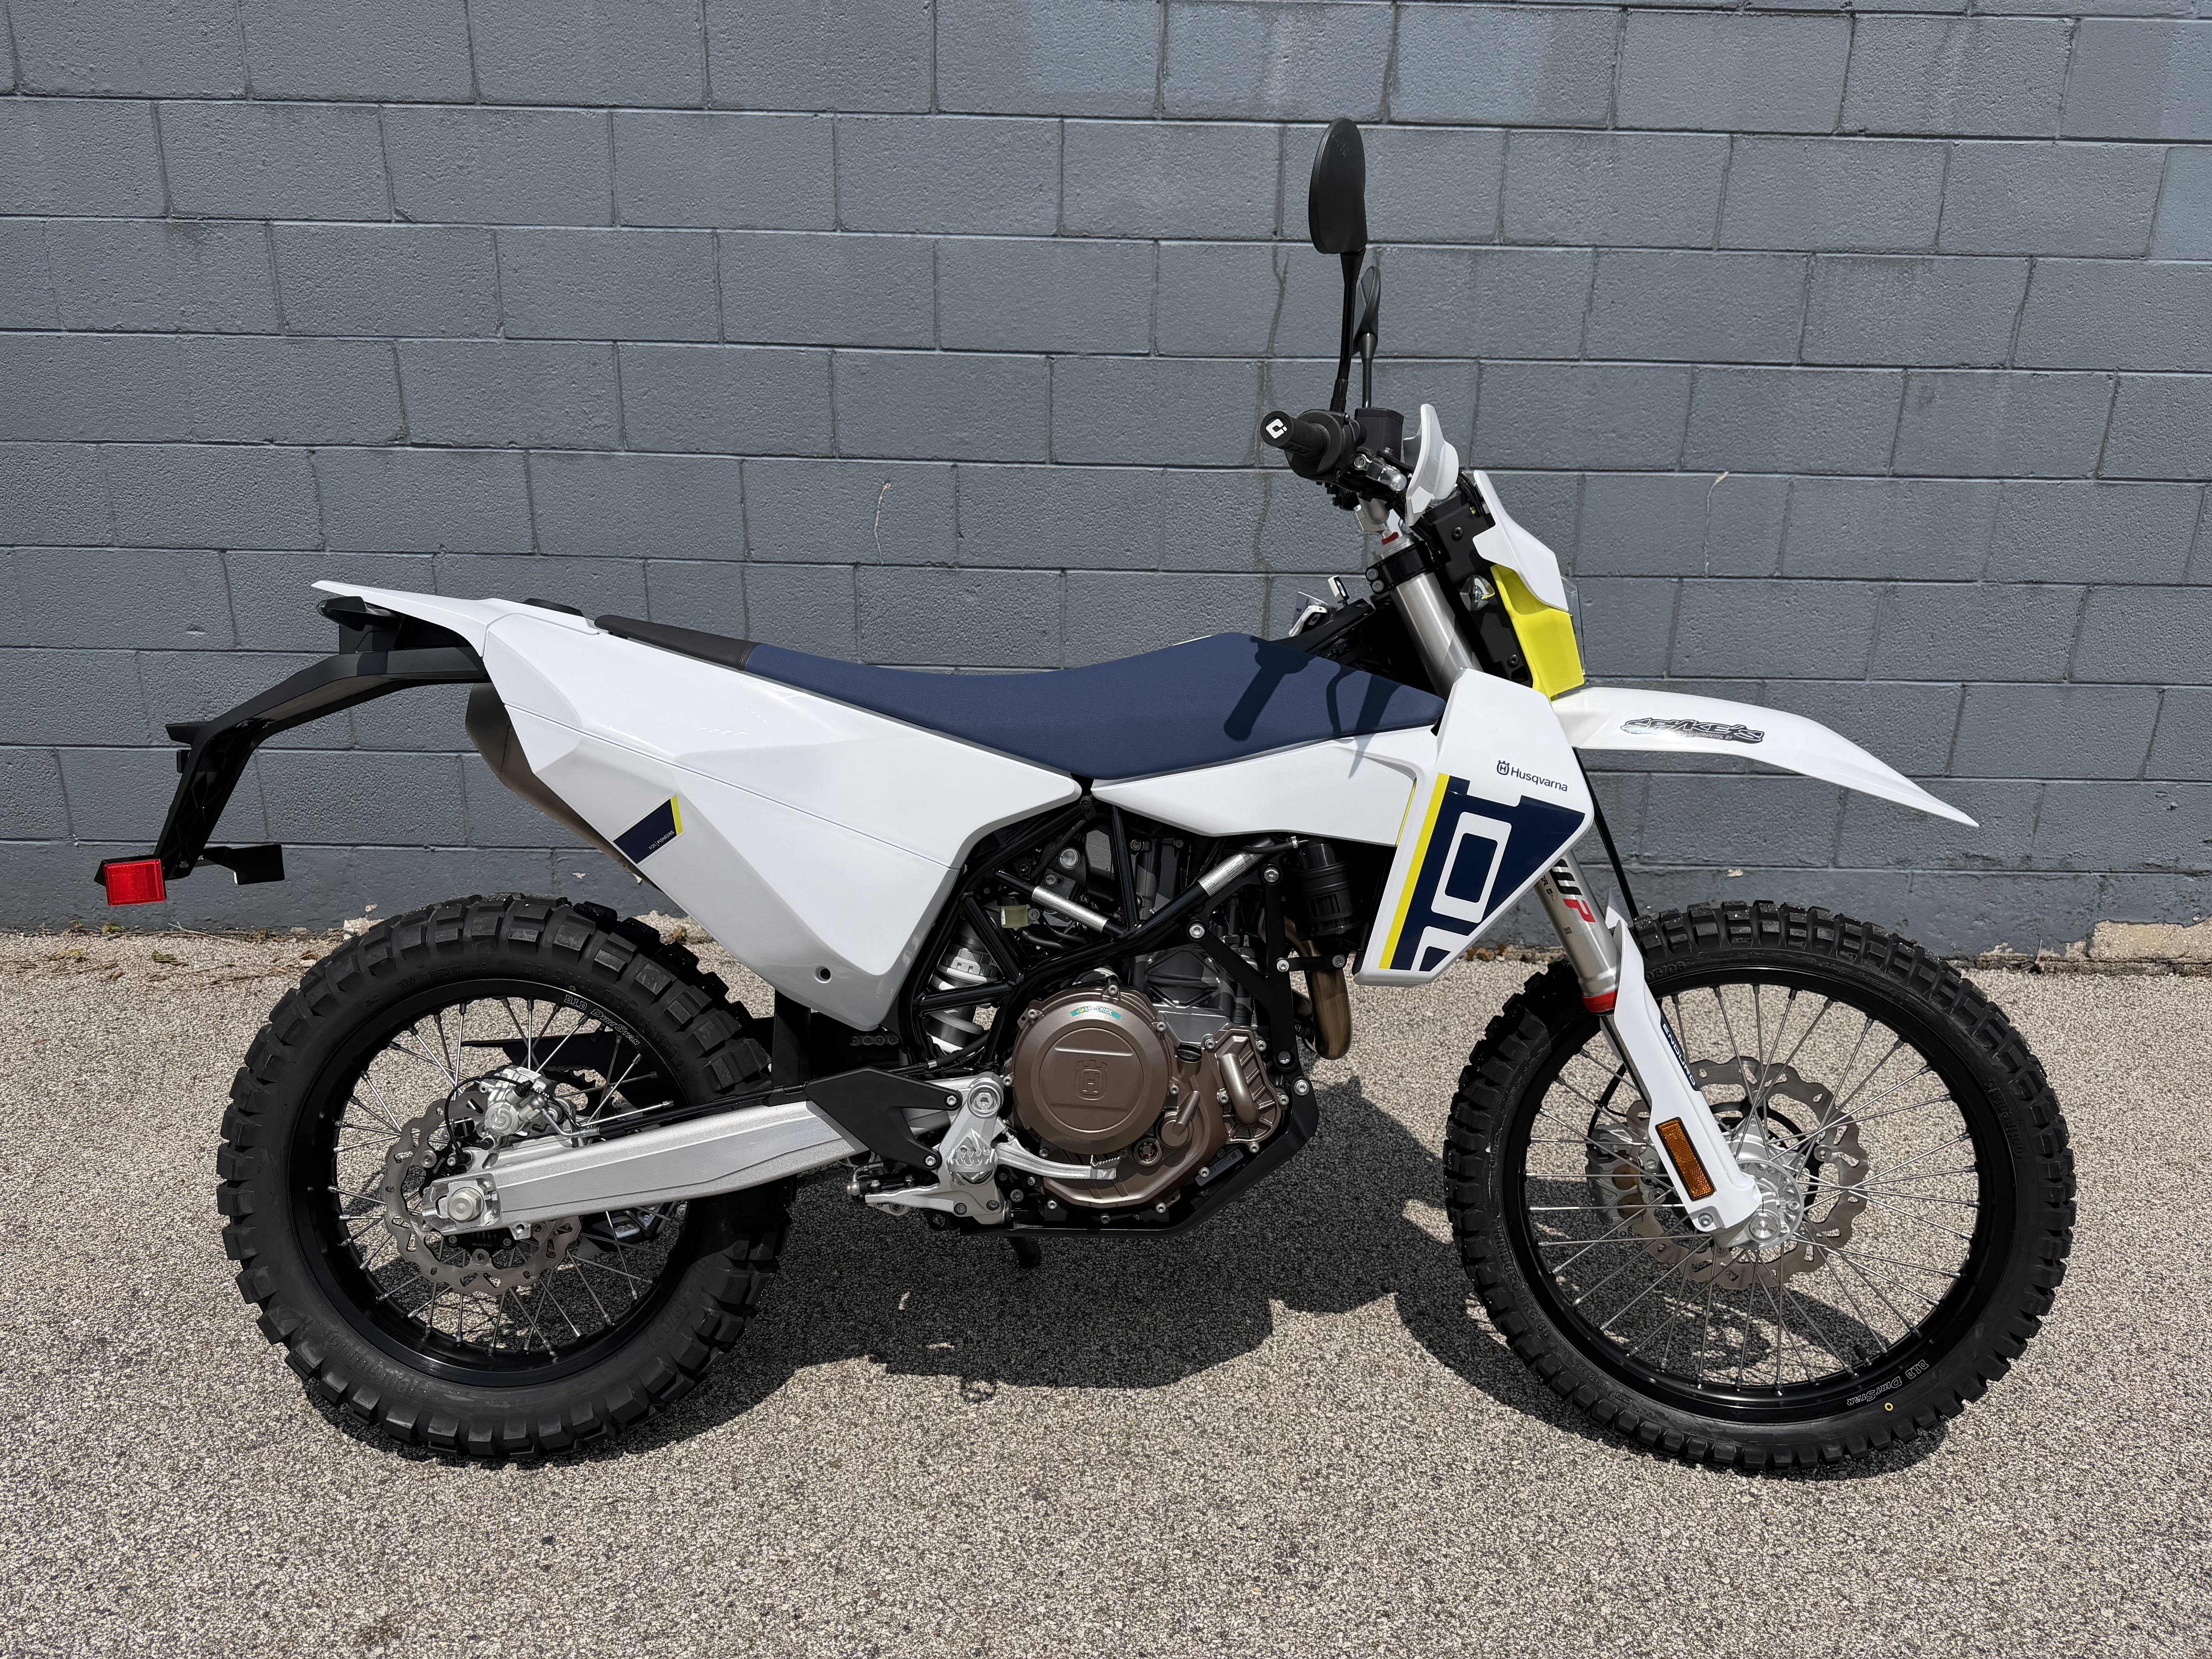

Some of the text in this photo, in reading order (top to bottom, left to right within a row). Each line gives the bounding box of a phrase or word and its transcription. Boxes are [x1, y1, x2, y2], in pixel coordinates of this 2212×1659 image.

[1511, 767, 1568, 792] Husqvarna
[656, 830, 674, 844] PIONEERS
[1085, 1005, 1113, 1015] MOTOREX
[1663, 1024, 1696, 1086] ENDURO
